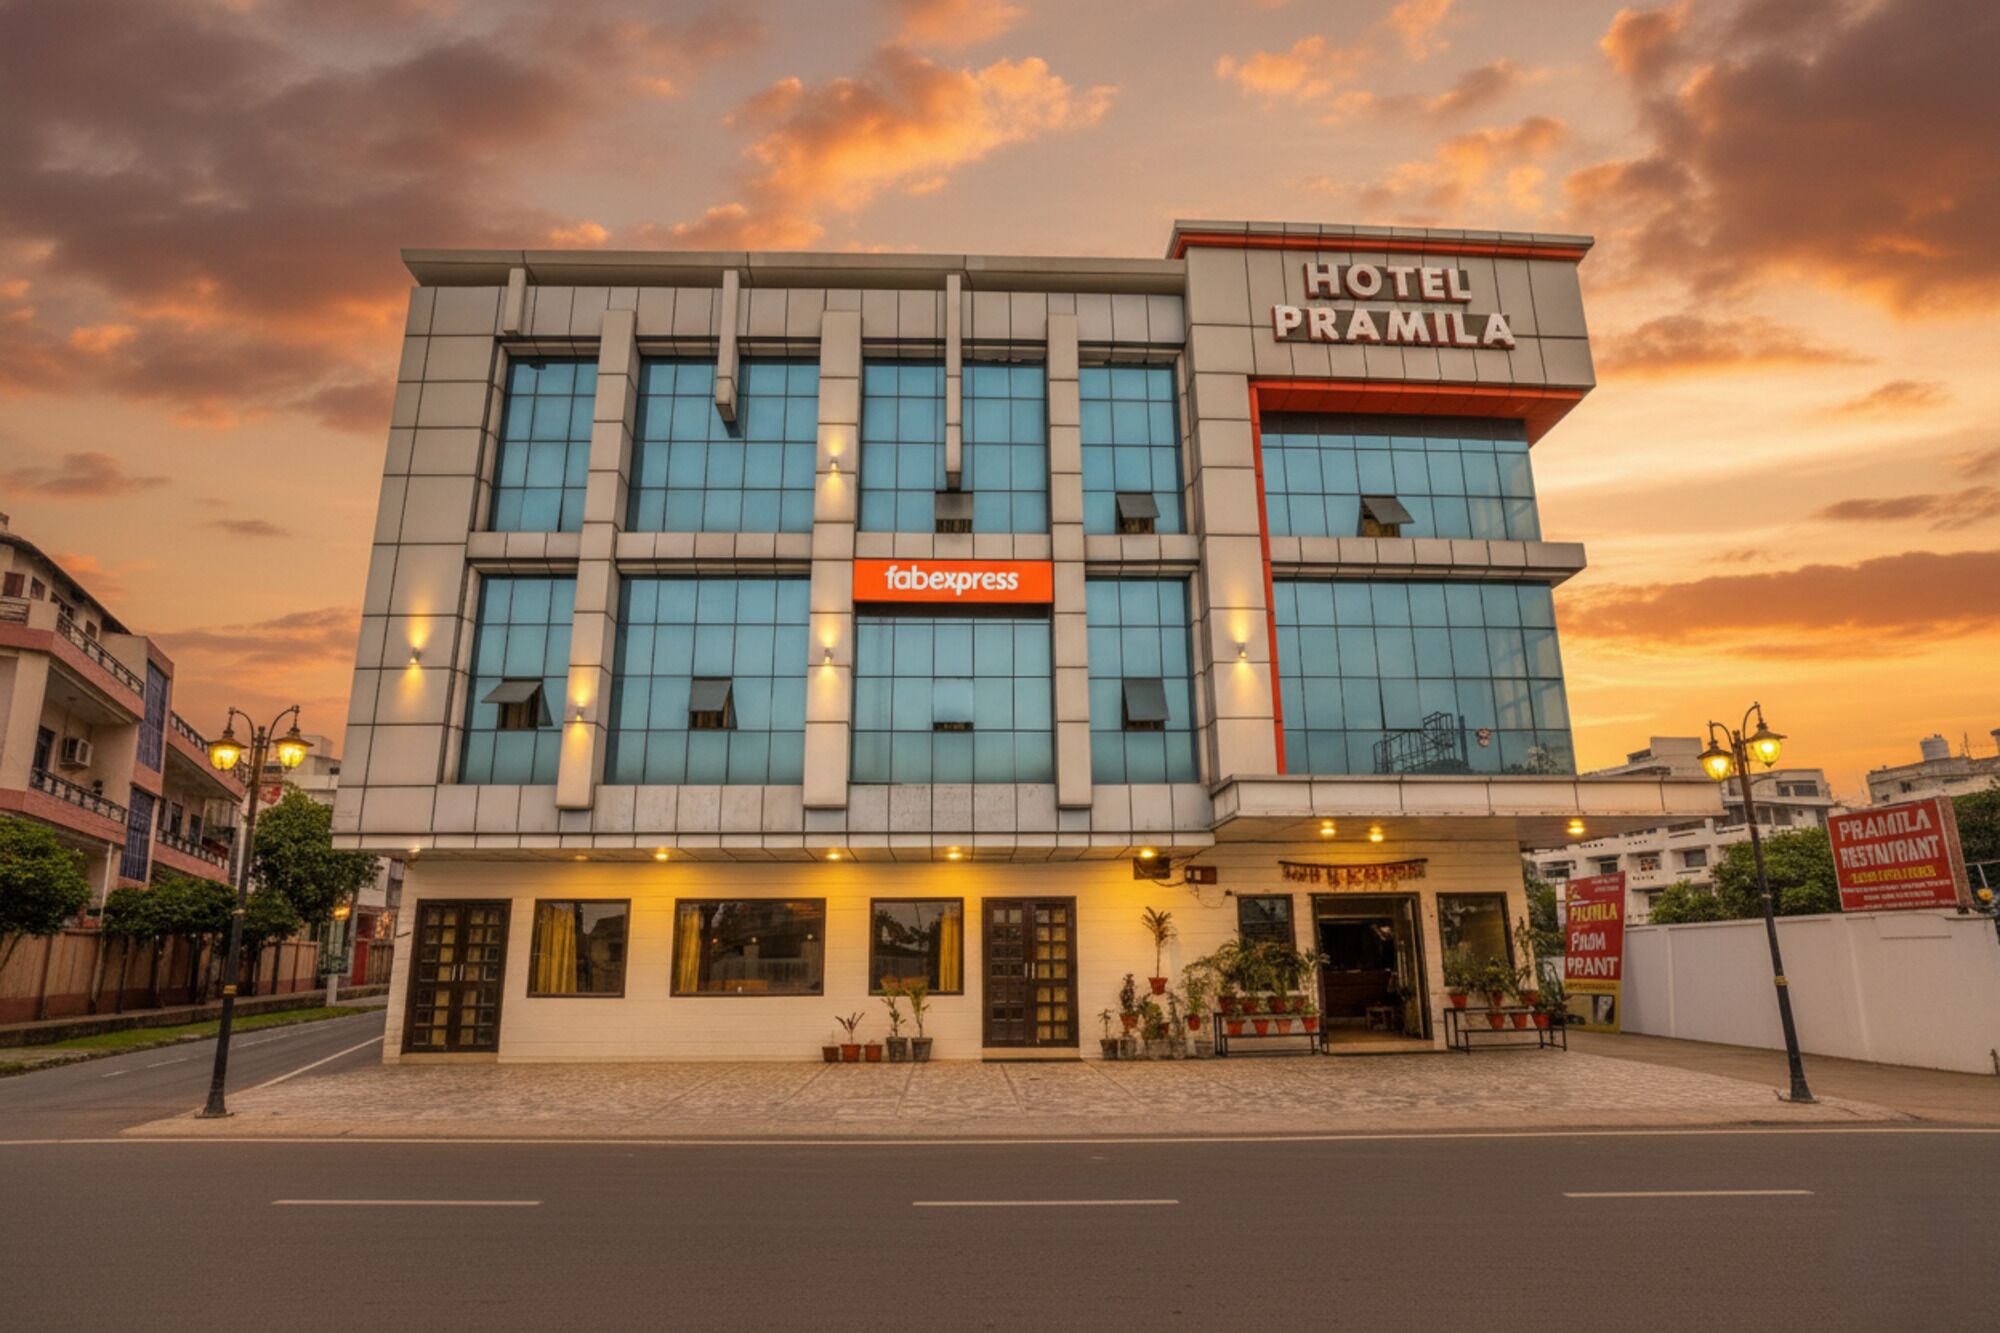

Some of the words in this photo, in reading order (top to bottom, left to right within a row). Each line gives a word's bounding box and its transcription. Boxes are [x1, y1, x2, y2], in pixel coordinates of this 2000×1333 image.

[1304, 263, 1472, 302] HOTEL
[1272, 305, 1516, 350] PRAMILA
[884, 565, 1019, 596] fabexpress
[1837, 808, 1932, 842] PRAMILA
